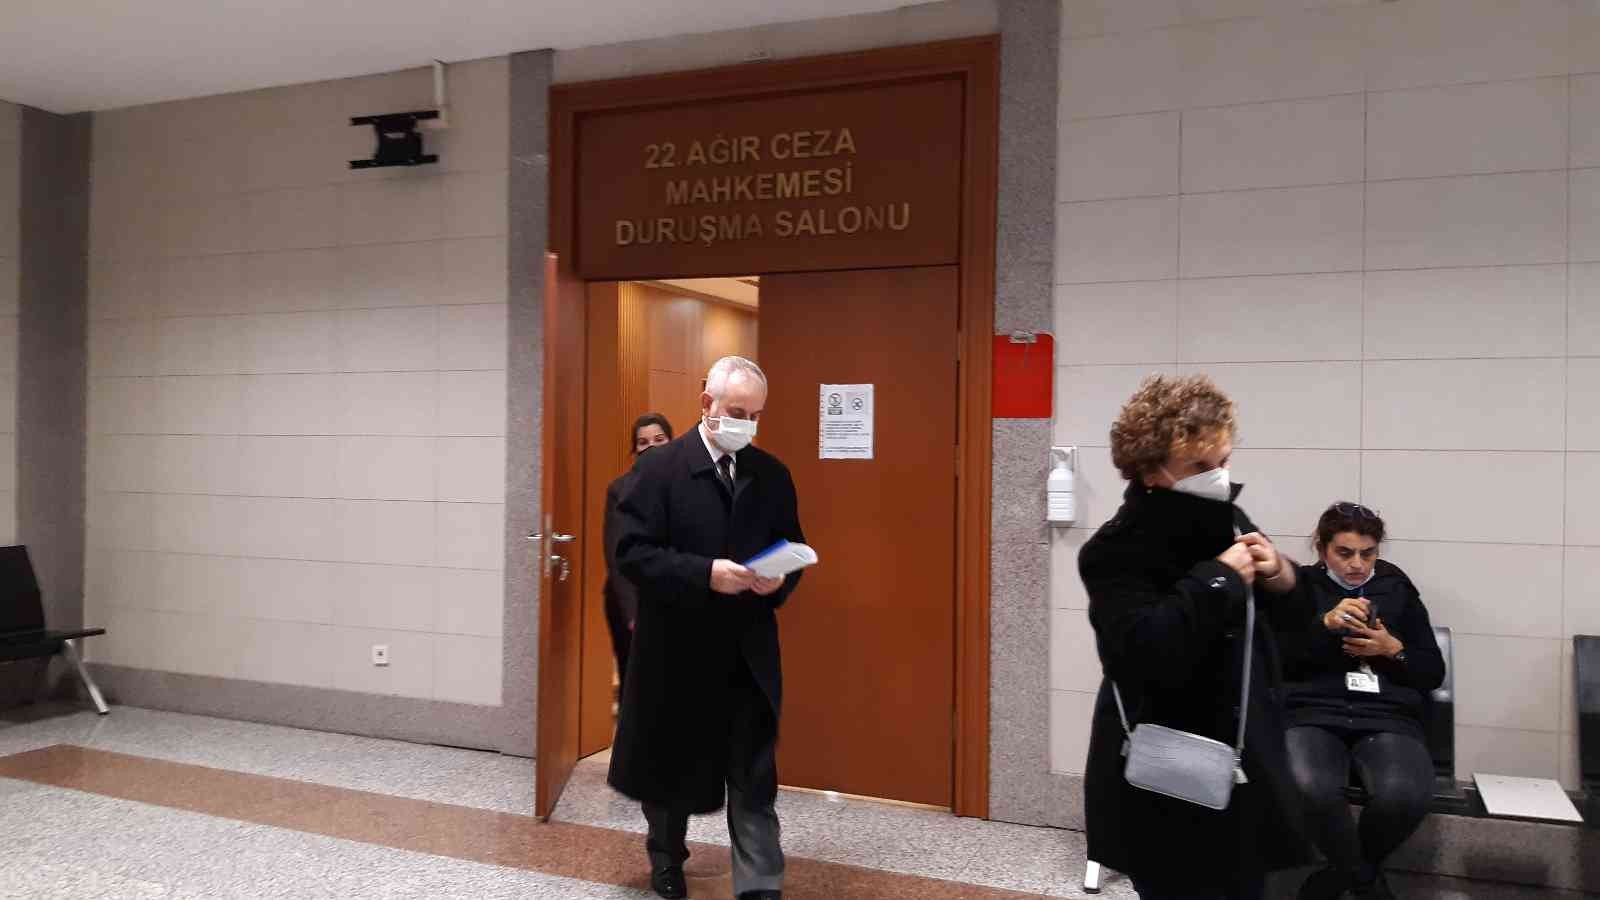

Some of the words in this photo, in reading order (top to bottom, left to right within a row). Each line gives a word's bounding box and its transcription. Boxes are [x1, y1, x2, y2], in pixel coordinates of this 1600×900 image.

[645, 143, 682, 169] 22.
[686, 134, 760, 165] AĞIR
[770, 127, 856, 160] CEZA
[665, 162, 853, 205] MAHKEMESİ
[615, 213, 763, 247] DURUŞMA
[775, 202, 910, 237] SALONU
